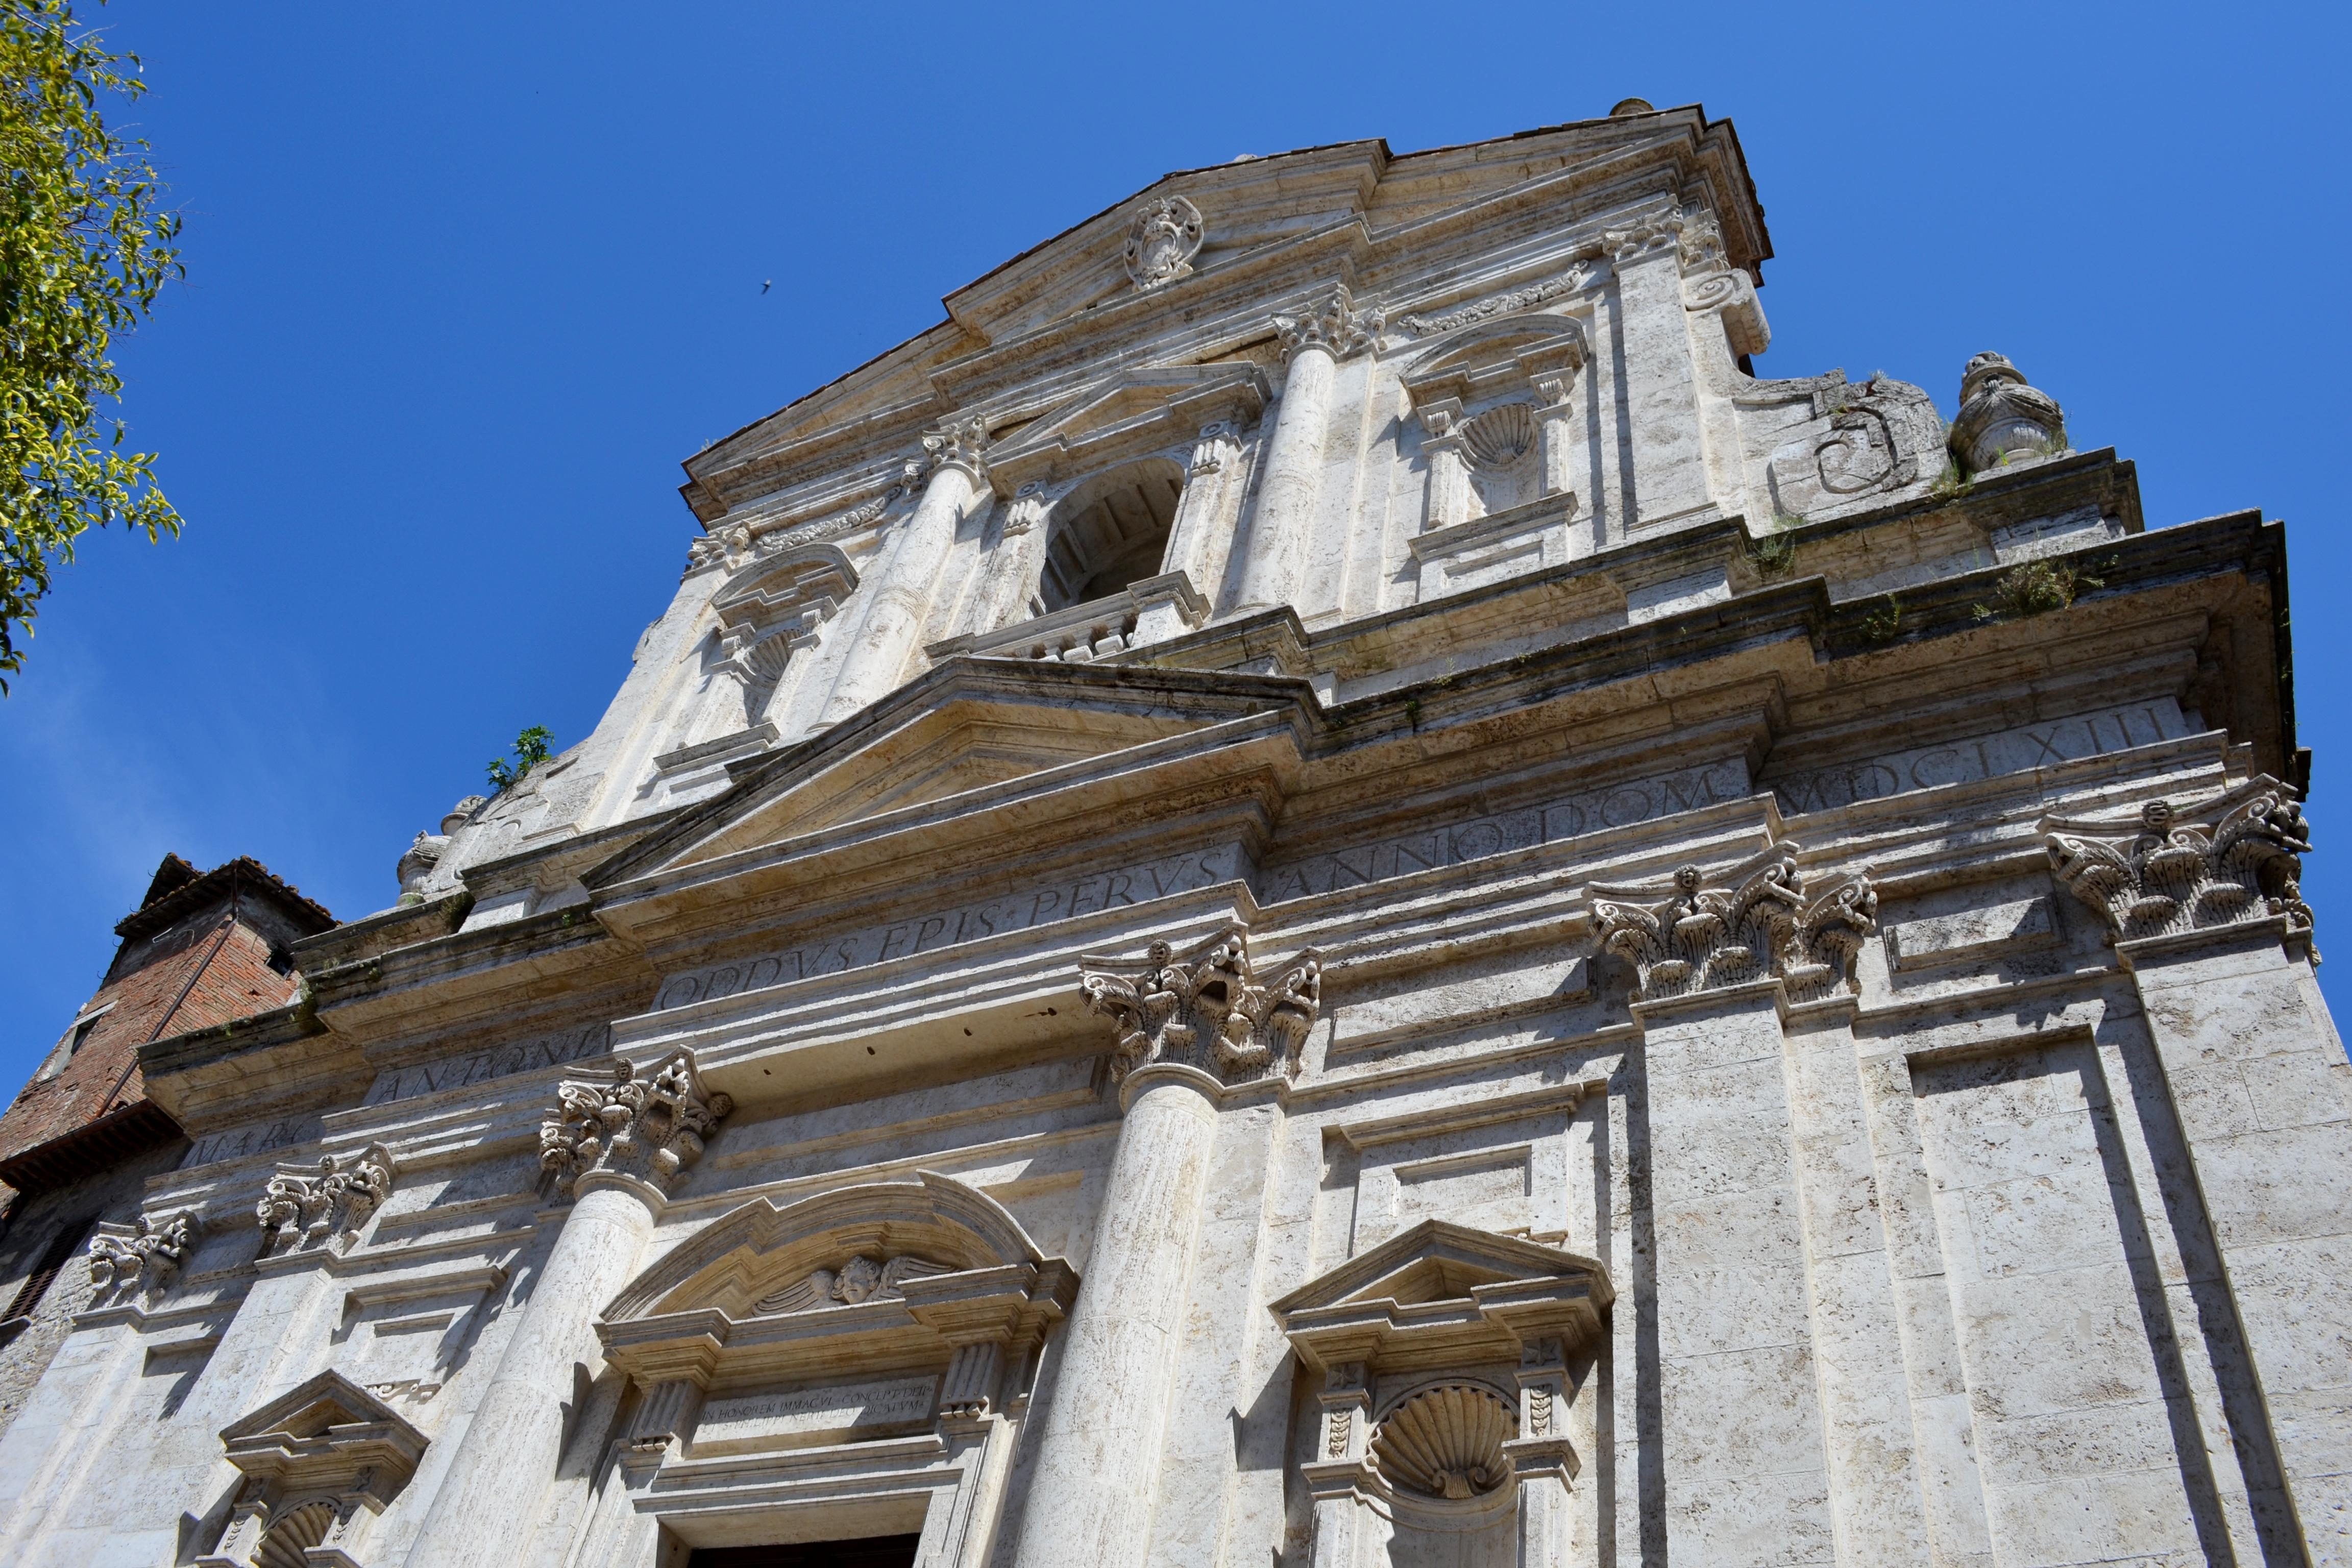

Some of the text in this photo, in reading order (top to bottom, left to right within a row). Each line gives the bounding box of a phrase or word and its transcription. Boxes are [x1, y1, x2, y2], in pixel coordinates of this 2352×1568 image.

[1028, 853, 1222, 927] PERVS
[1278, 823, 1504, 902] ANNO
[1536, 769, 1717, 844] DOM
[702, 1410, 715, 1420] IN
[718, 1402, 776, 1419] HONOREM
[829, 1406, 855, 1418] DEO
